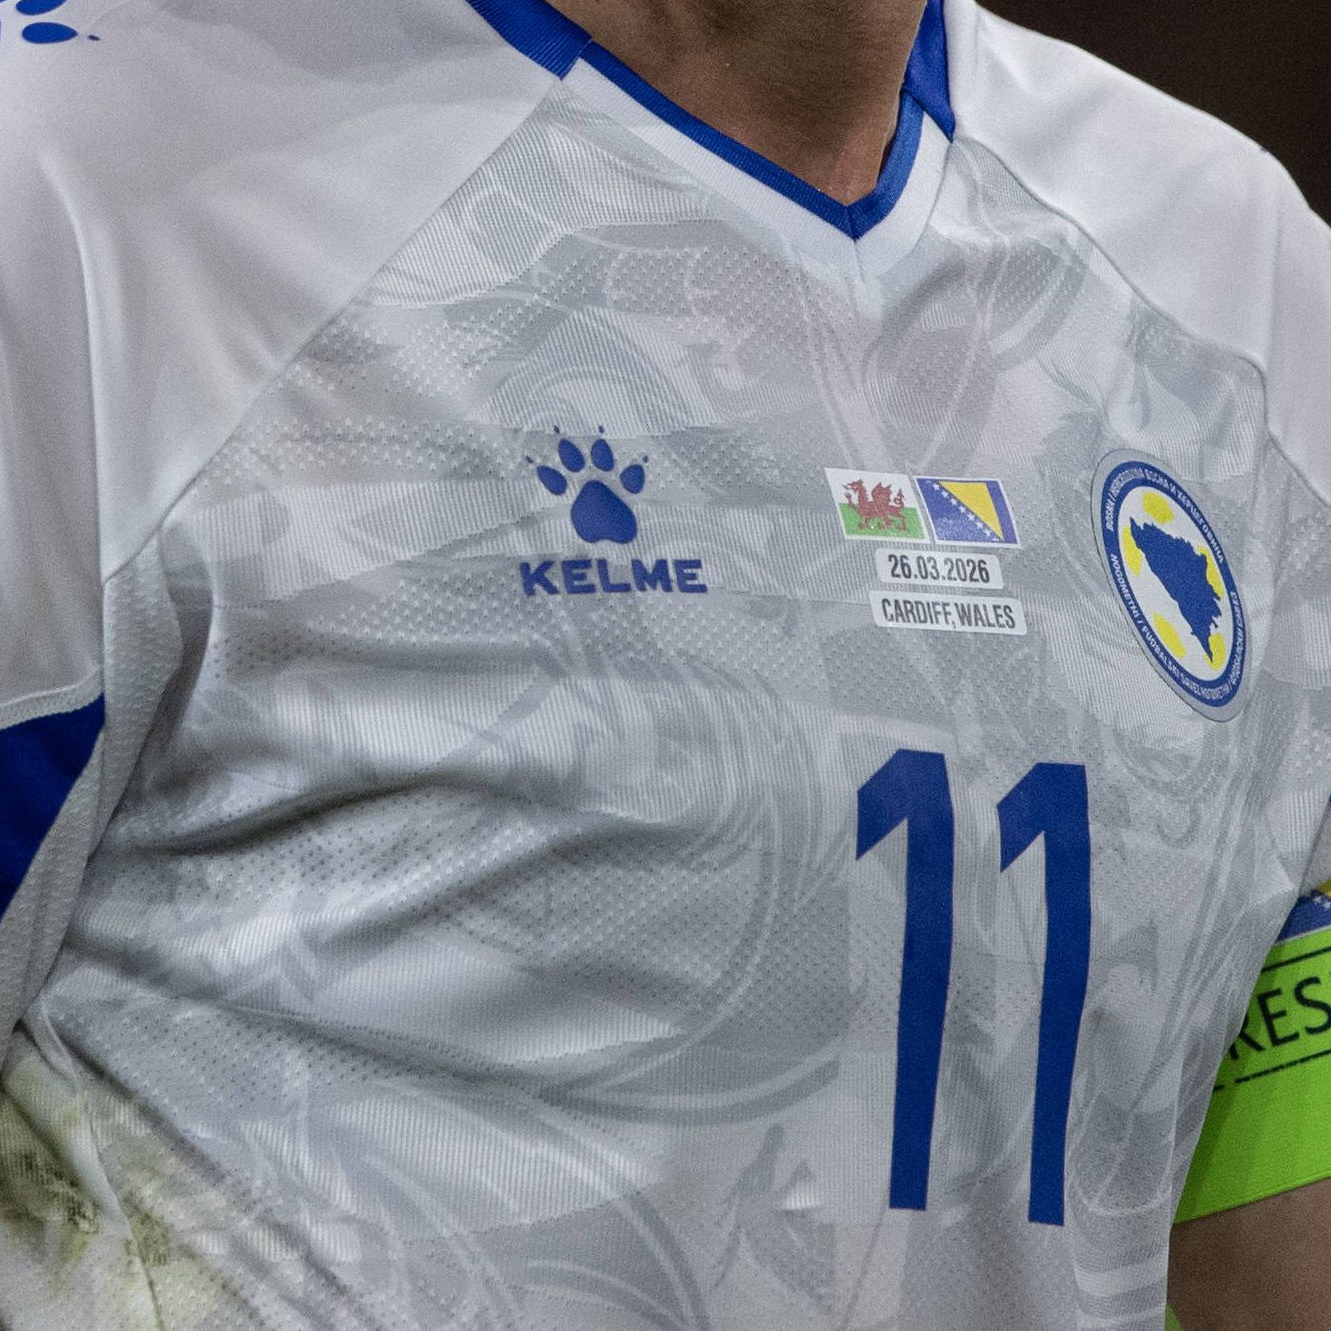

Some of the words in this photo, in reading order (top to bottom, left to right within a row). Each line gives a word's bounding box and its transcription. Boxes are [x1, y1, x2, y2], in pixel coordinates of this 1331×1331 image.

[520, 558, 708, 596] KELME
[888, 553, 990, 584] 26.03.2026
[855, 748, 1092, 1227] 11
